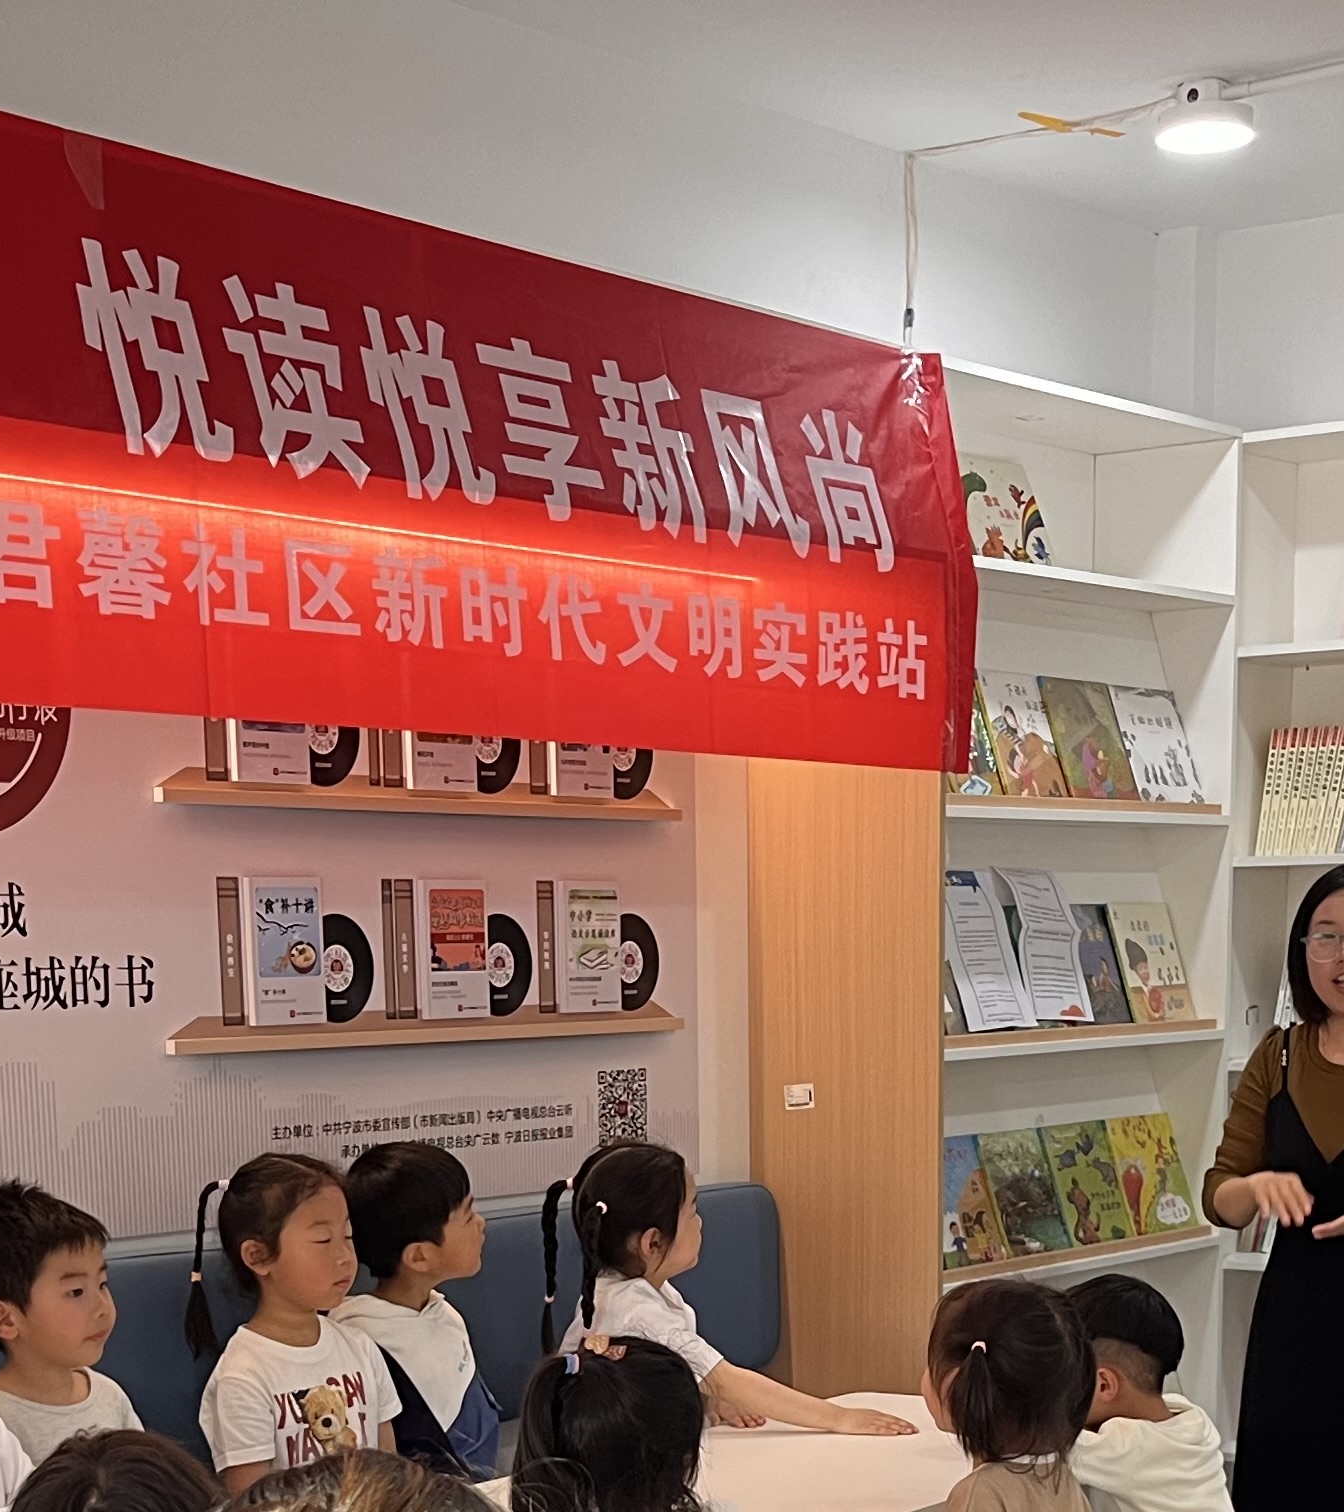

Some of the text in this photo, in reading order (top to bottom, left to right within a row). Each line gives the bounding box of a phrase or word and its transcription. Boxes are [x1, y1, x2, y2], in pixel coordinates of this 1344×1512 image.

[78, 234, 895, 572] 悦读悦享新风尚
